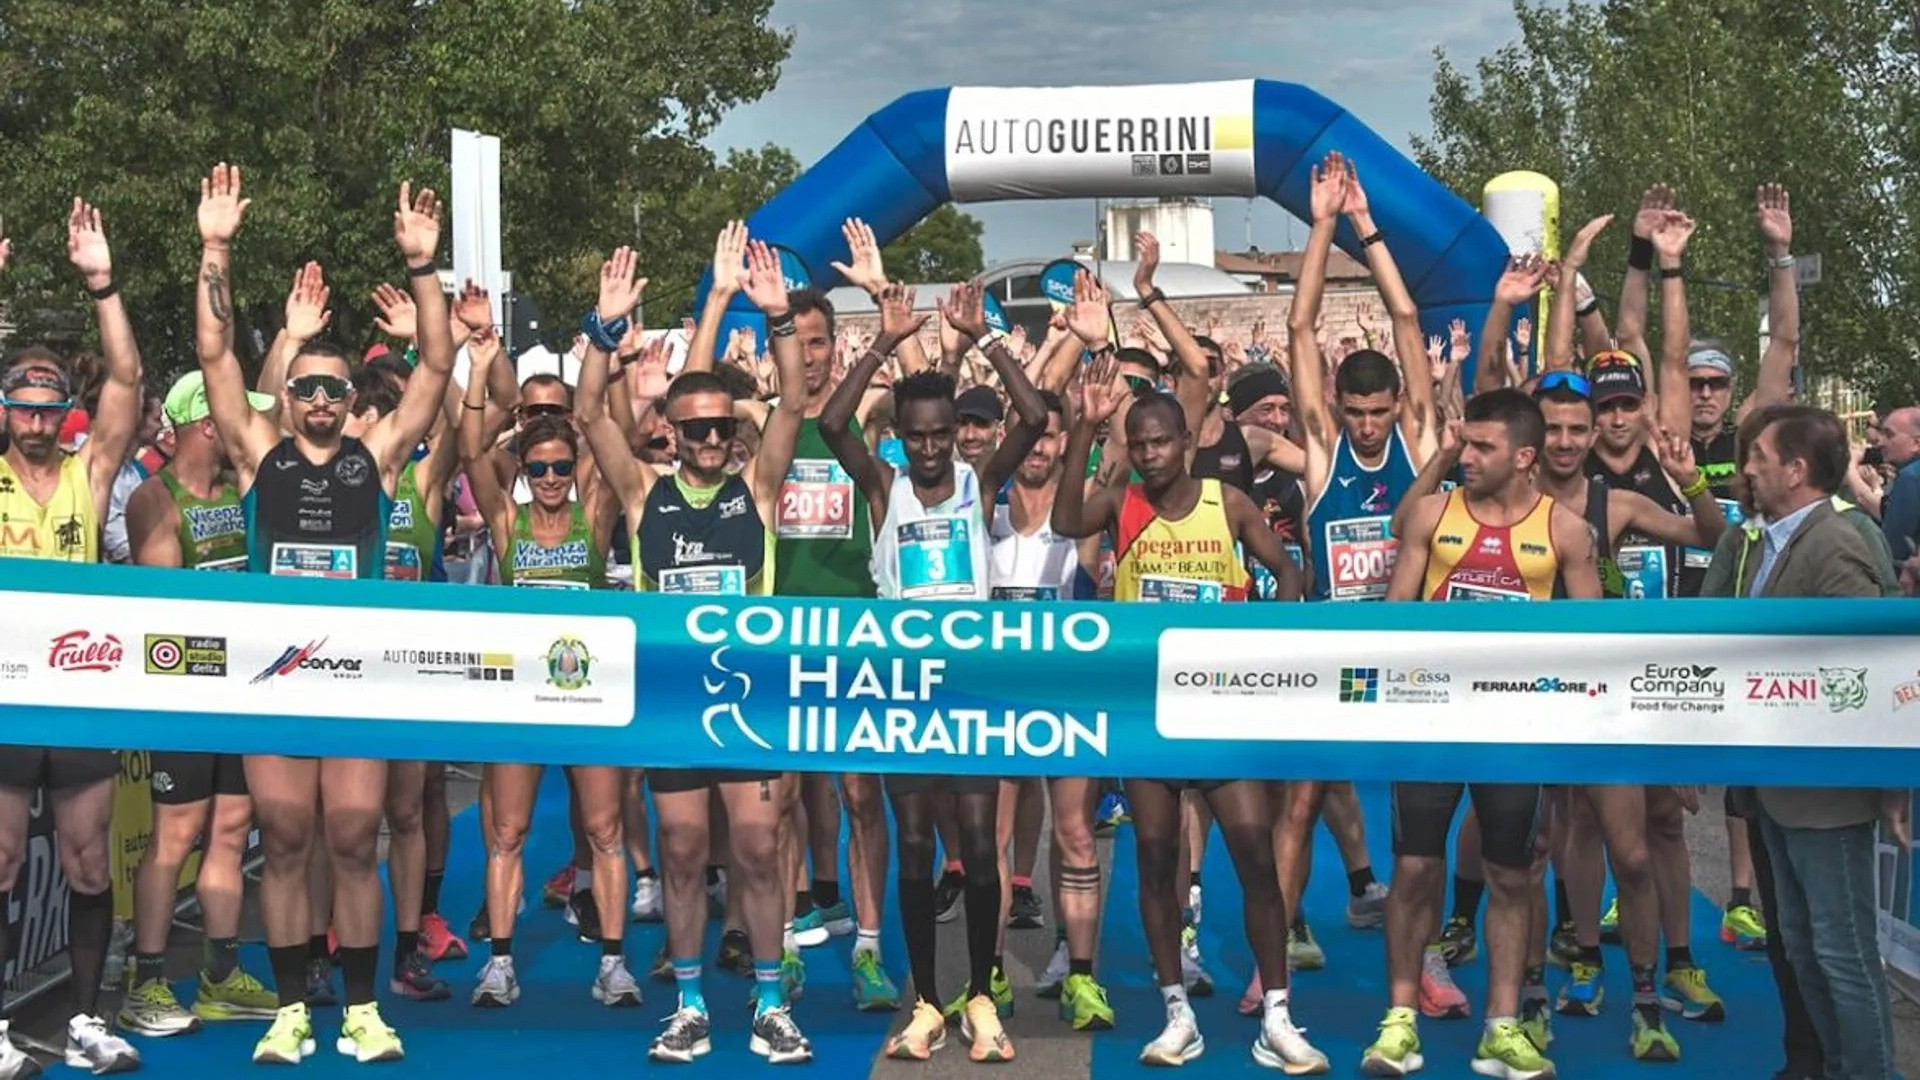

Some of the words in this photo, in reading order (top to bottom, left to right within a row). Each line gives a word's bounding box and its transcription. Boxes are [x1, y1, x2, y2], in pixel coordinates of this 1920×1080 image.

[954, 115, 1211, 154] AUTOGUERRINI
[783, 490, 844, 520] 2013
[516, 540, 588, 559] Vicenza
[1136, 540, 1222, 560] pegarun
[513, 553, 589, 571] Marathon
[928, 549, 946, 581] 3
[1179, 560, 1227, 574] BEAUTY
[383, 650, 482, 665] AUTOGUERRINI
[789, 655, 946, 701] HALF
[1386, 668, 1406, 682] La
[1645, 663, 1691, 679] Euro
[1630, 676, 1725, 697] Company
[1746, 678, 1817, 700] ZANI
[1630, 701, 1660, 711] Food
[1661, 701, 1679, 711] for
[1680, 701, 1725, 714] Change
